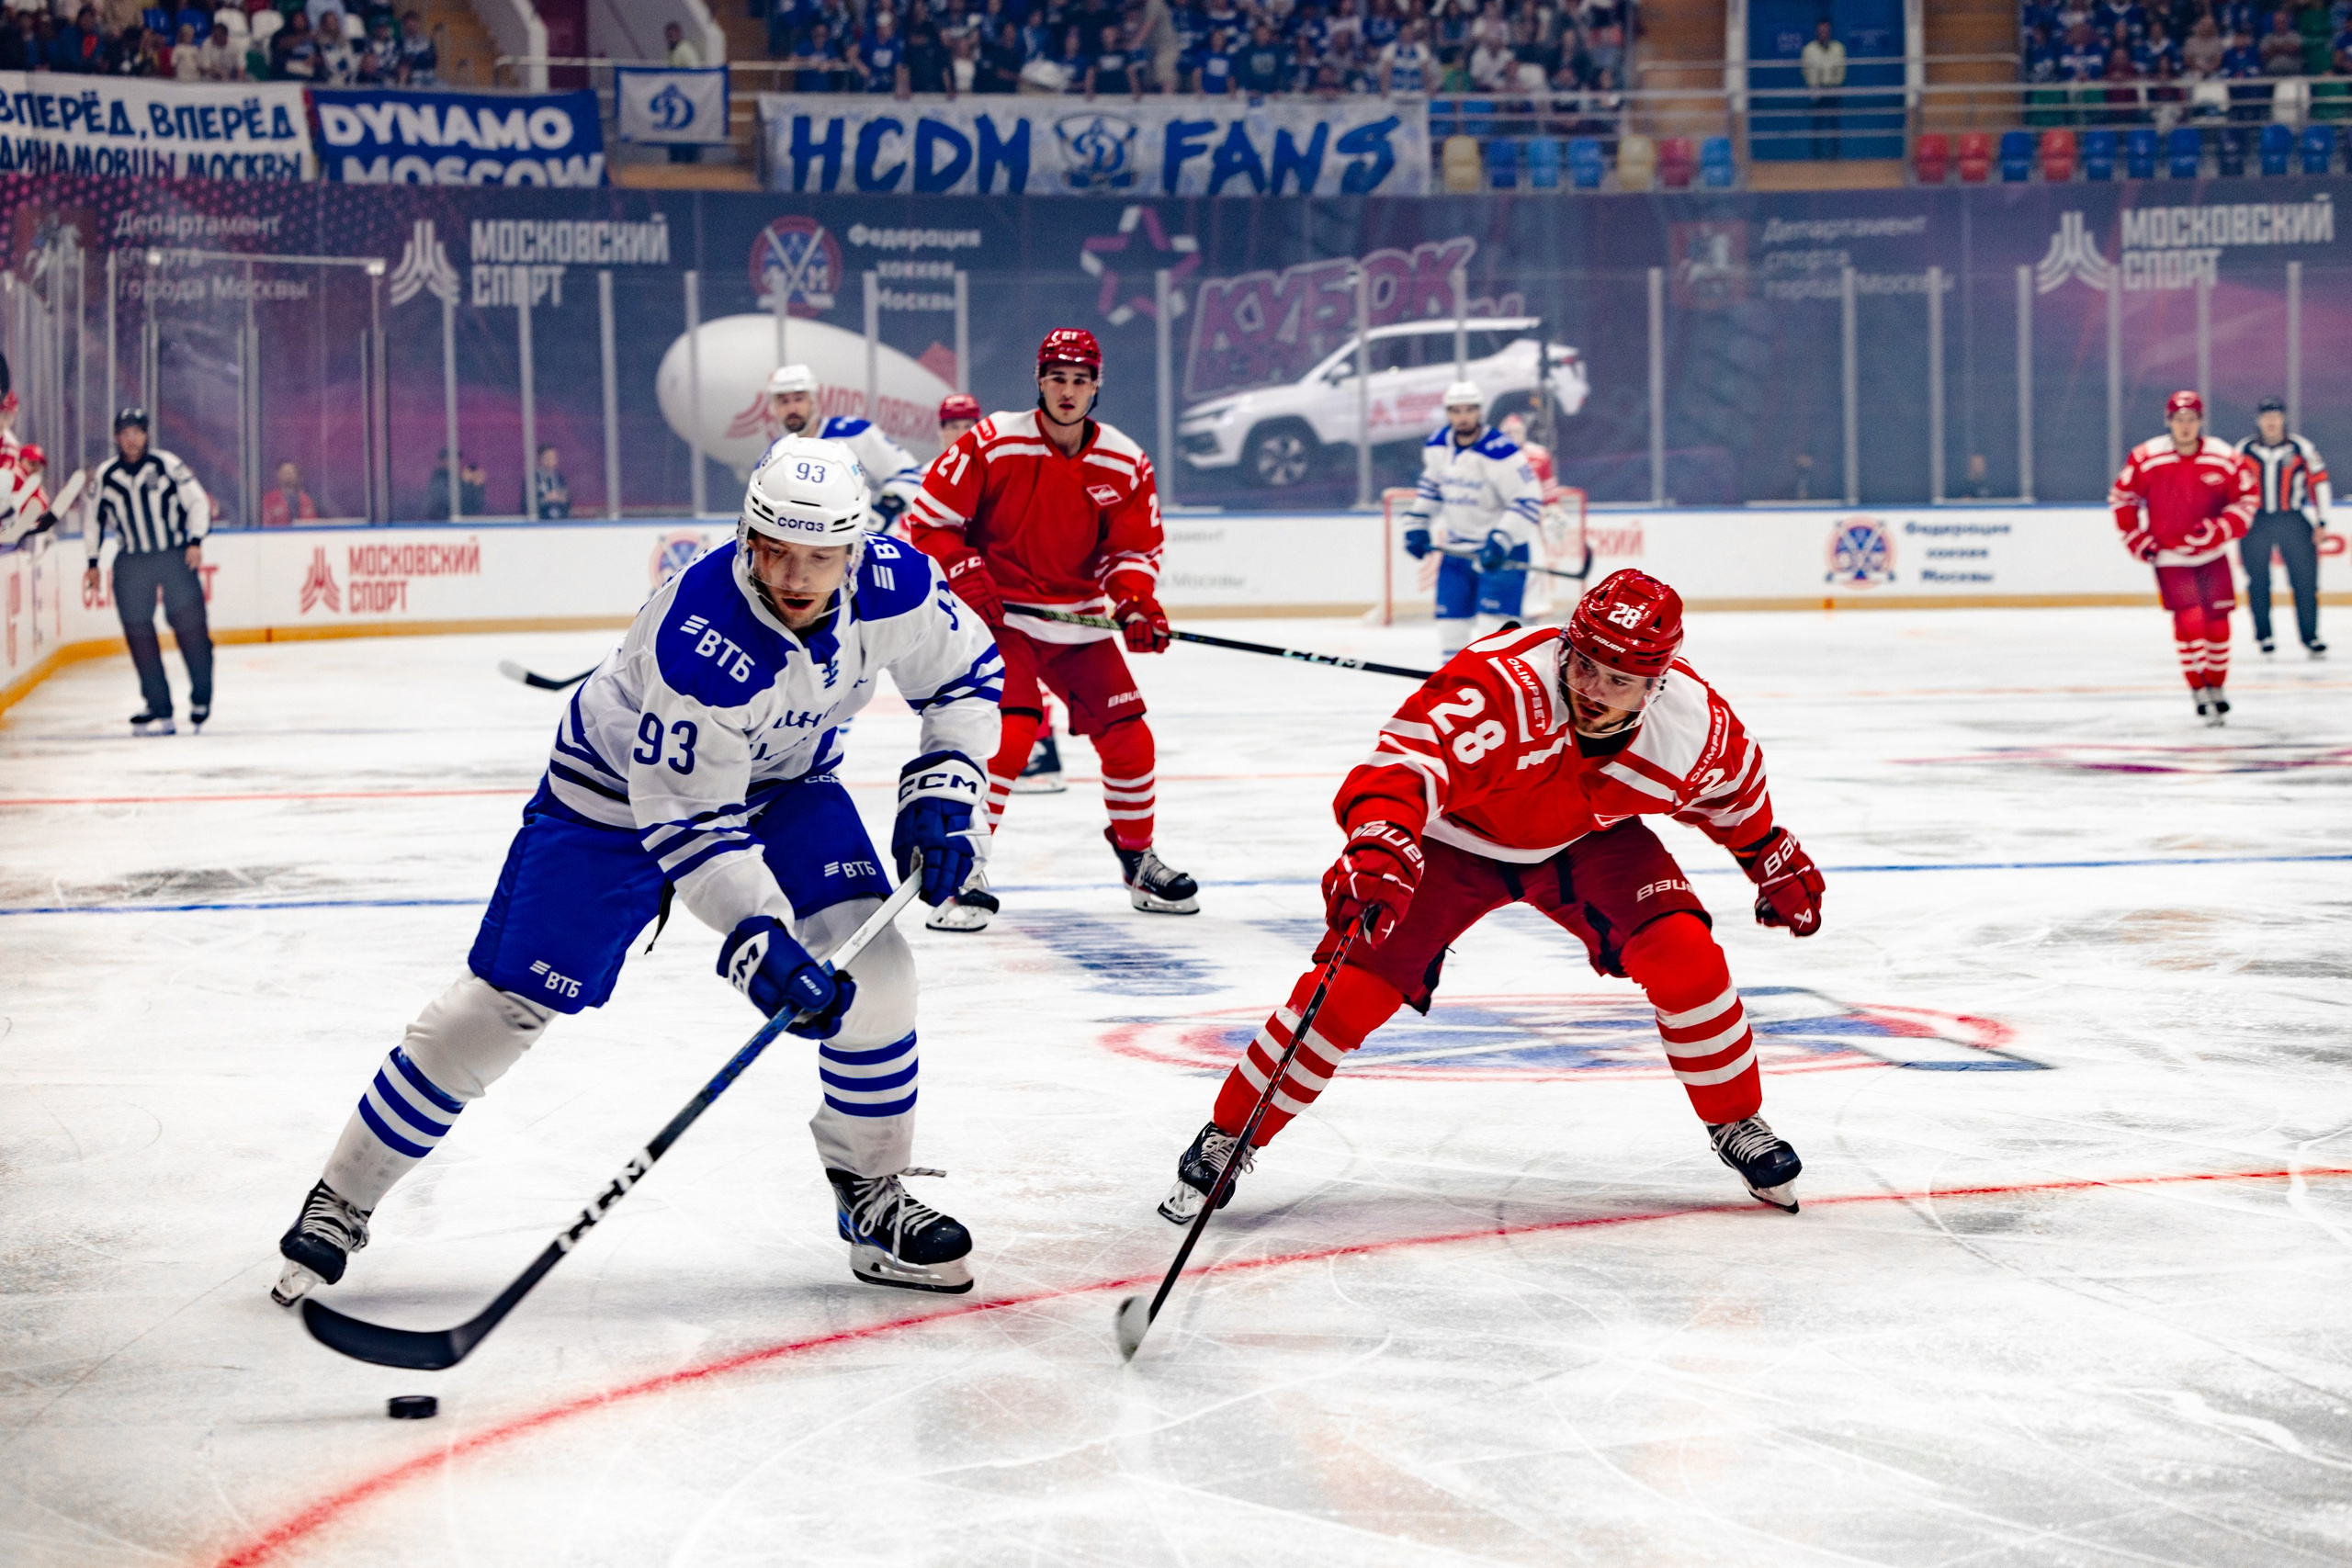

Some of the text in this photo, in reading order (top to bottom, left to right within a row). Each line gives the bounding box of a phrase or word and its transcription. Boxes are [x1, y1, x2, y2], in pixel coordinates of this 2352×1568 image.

[148, 97, 296, 140] ВПЕРЁД
[318, 102, 574, 151] DYNAMO
[342, 152, 605, 186] MOSCOW
[791, 112, 1031, 195] HCDM
[1163, 115, 1401, 196] FANS
[471, 212, 670, 264] МОСКОВСКИЙ
[2121, 193, 2335, 248] МОСКОВСКИЙ
[471, 265, 566, 308] СПОРТ
[2122, 249, 2222, 290] СПОРТ
[796, 462, 826, 483] 93
[936, 444, 971, 487] 21
[777, 516, 825, 533] согаз
[1148, 491, 1160, 528] 2
[348, 535, 481, 575] МОСКОВСКИЙ
[949, 556, 985, 580] CC
[348, 580, 407, 614] СПОРТ
[1607, 602, 1644, 630] 28
[695, 628, 756, 683] ВТБ
[1506, 657, 1547, 731] OLIMPBET
[633, 711, 698, 775] 93
[1427, 687, 1507, 765] 28
[1690, 705, 1723, 783] OLIMPBET
[898, 773, 978, 804] CCM
[1697, 767, 1728, 796] 2
[841, 861, 877, 879] ВТБ
[544, 971, 583, 998] ВТБ
